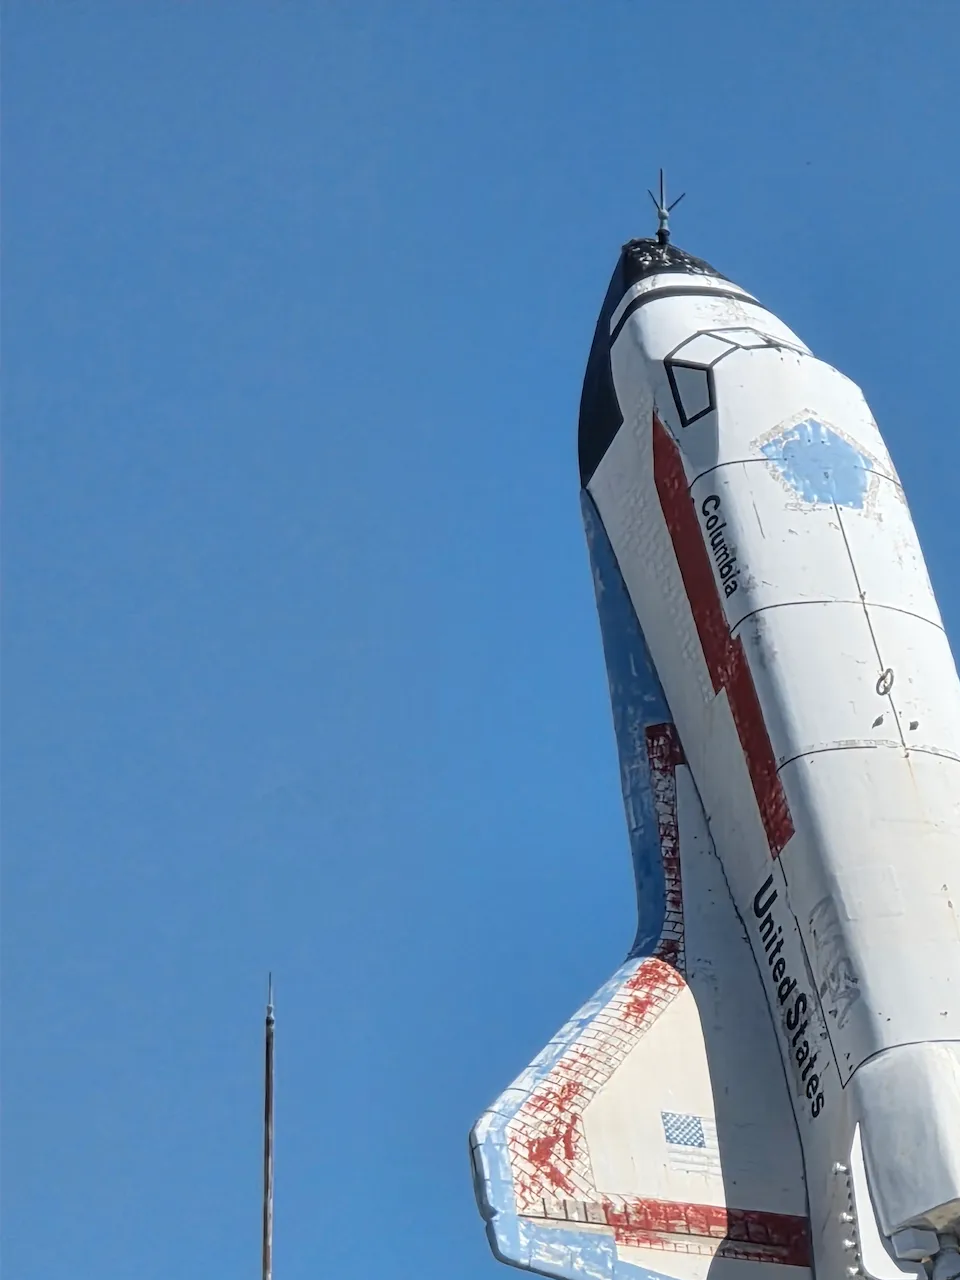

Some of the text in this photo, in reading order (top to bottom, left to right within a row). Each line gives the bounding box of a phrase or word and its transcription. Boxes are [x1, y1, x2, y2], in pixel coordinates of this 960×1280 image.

[702, 494, 741, 599] Columbia
[753, 873, 825, 1118] United States
